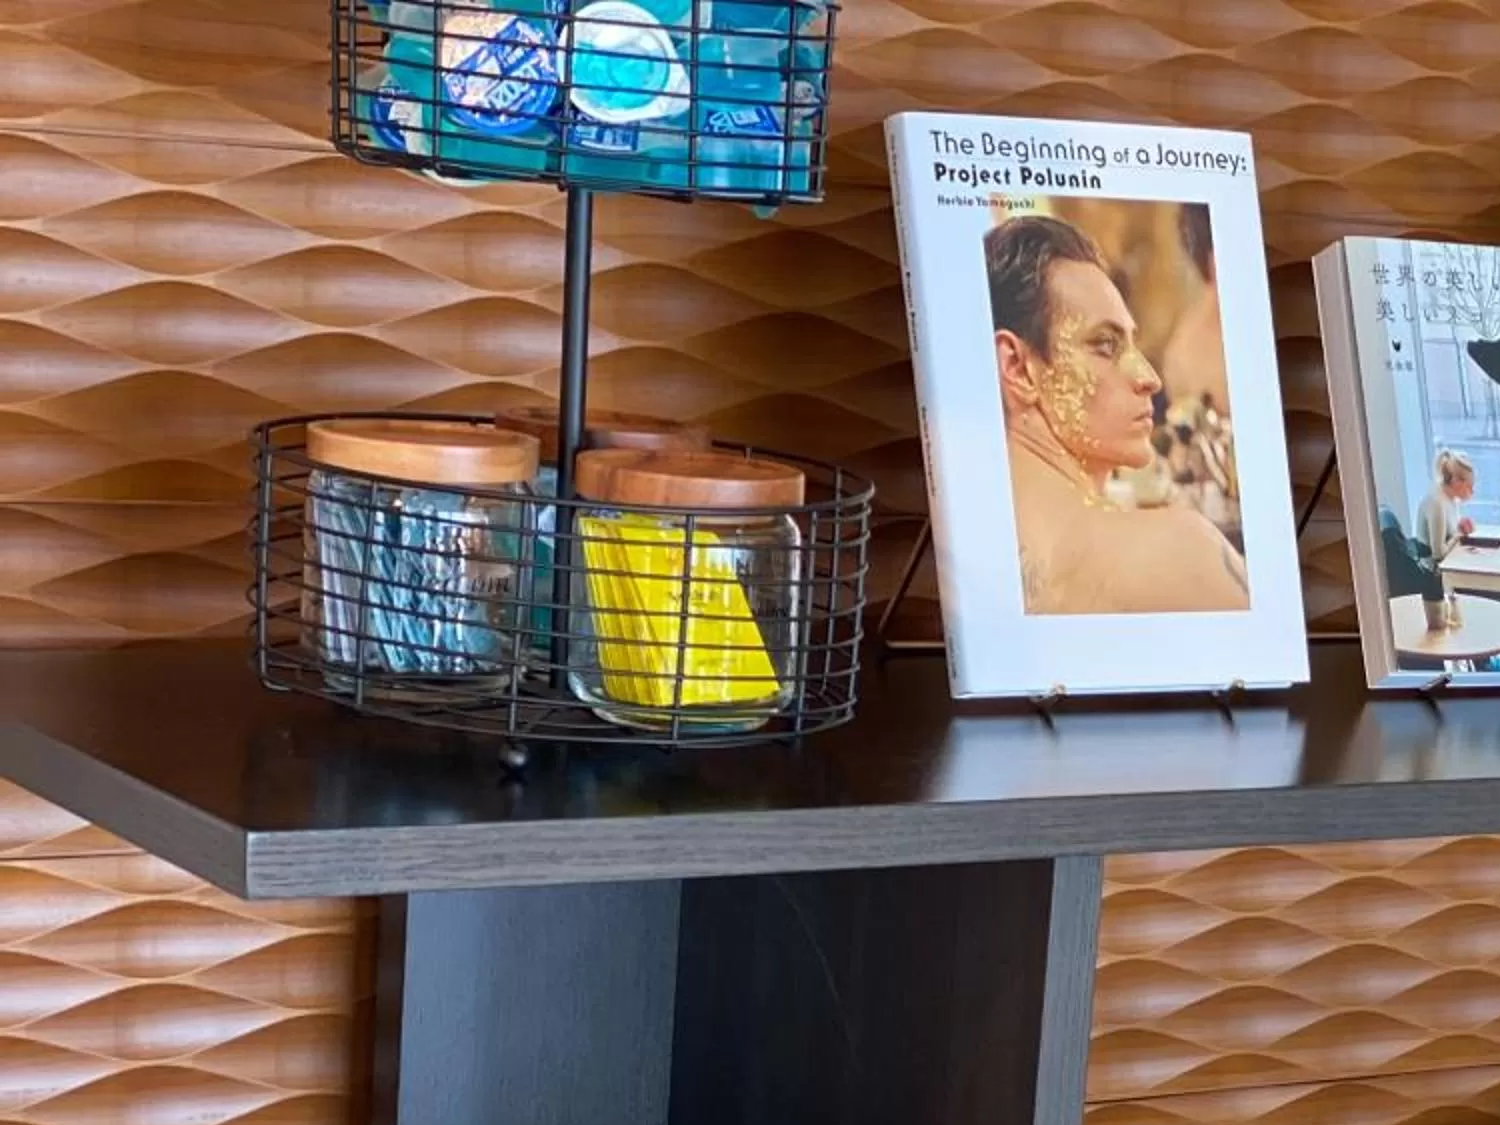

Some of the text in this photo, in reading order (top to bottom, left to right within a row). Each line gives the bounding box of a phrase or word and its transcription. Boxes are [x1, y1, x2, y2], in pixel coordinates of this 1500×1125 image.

[929, 131, 1248, 177] The Beginning of a Journey:
[933, 162, 1102, 190] Project Polunin
